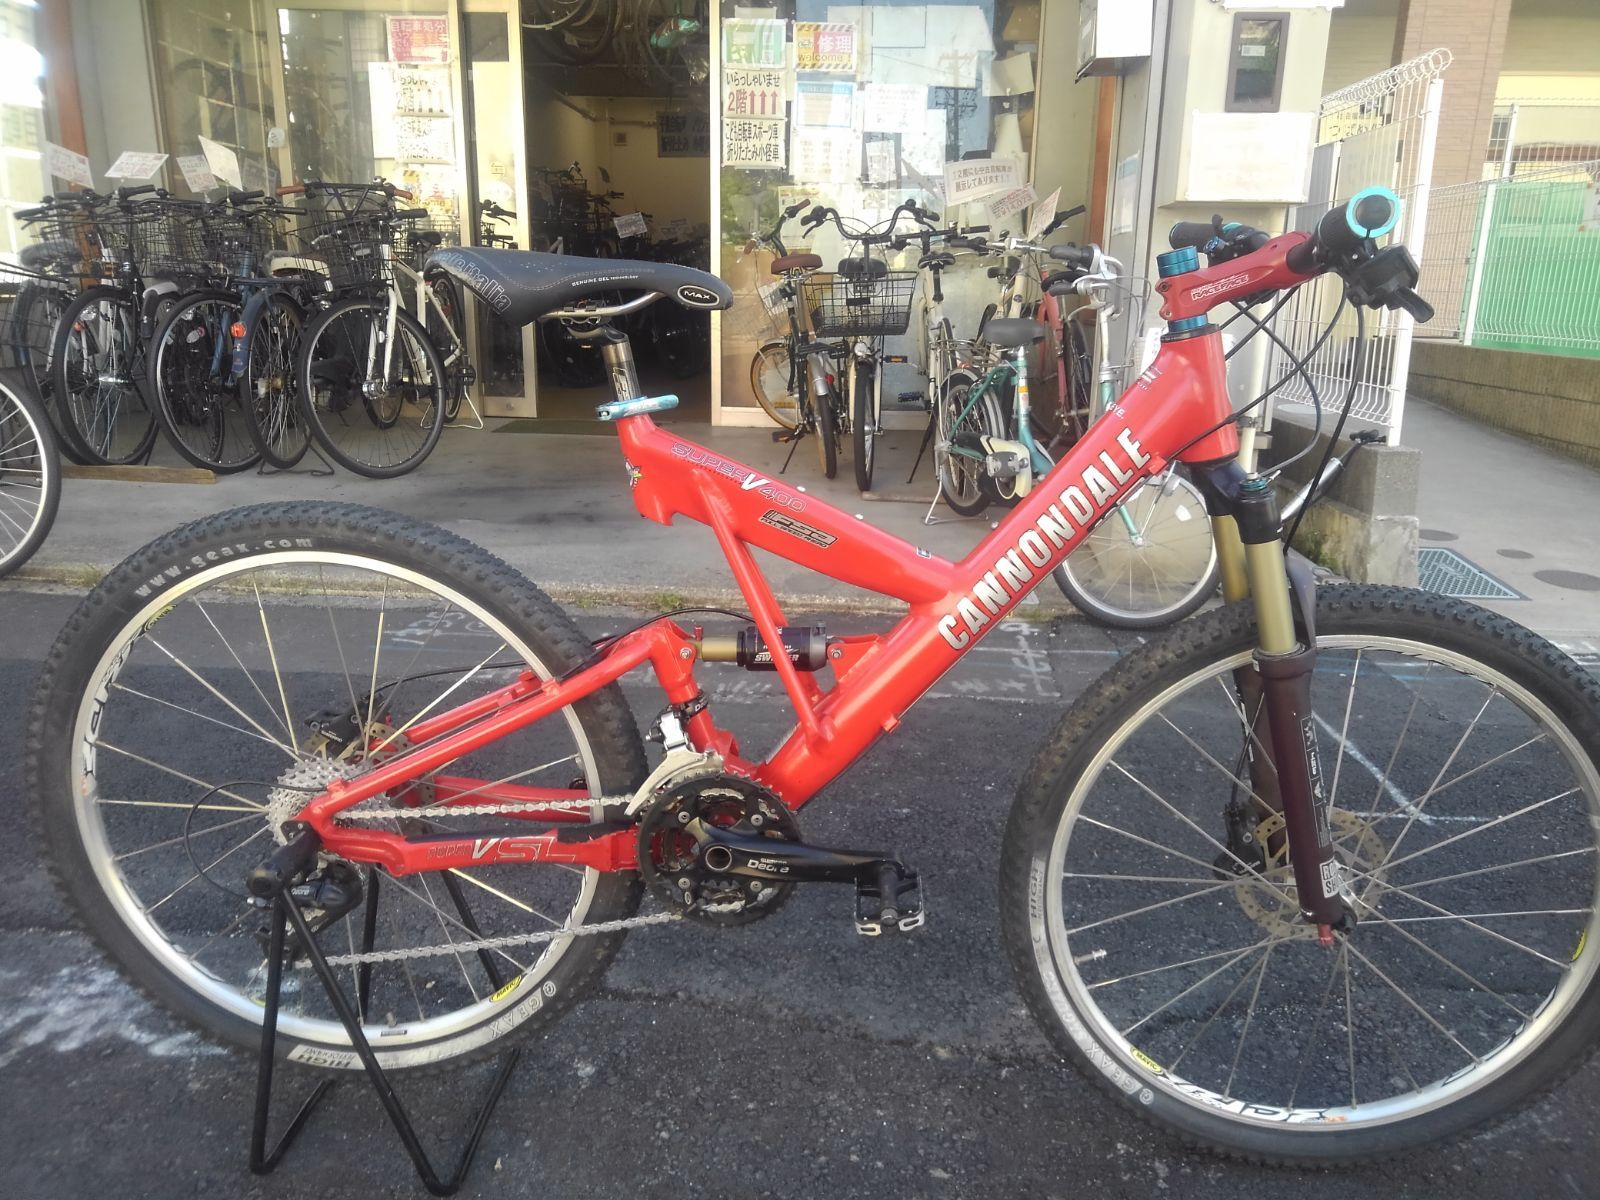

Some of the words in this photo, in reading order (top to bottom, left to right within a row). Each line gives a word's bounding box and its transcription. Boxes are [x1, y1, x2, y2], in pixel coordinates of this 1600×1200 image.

[818, 34, 853, 53] 修理
[799, 53, 843, 62] welcome
[726, 72, 780, 87] いらっしゃいませ
[728, 89, 747, 114] 2階
[684, 290, 710, 301] MAX
[937, 426, 1151, 651] CANNONDALE
[134, 538, 313, 598] www.geax.com
[487, 994, 542, 1039] GEAX
[297, 1053, 350, 1068] HIGH
[1083, 1041, 1139, 1093] GEAX
